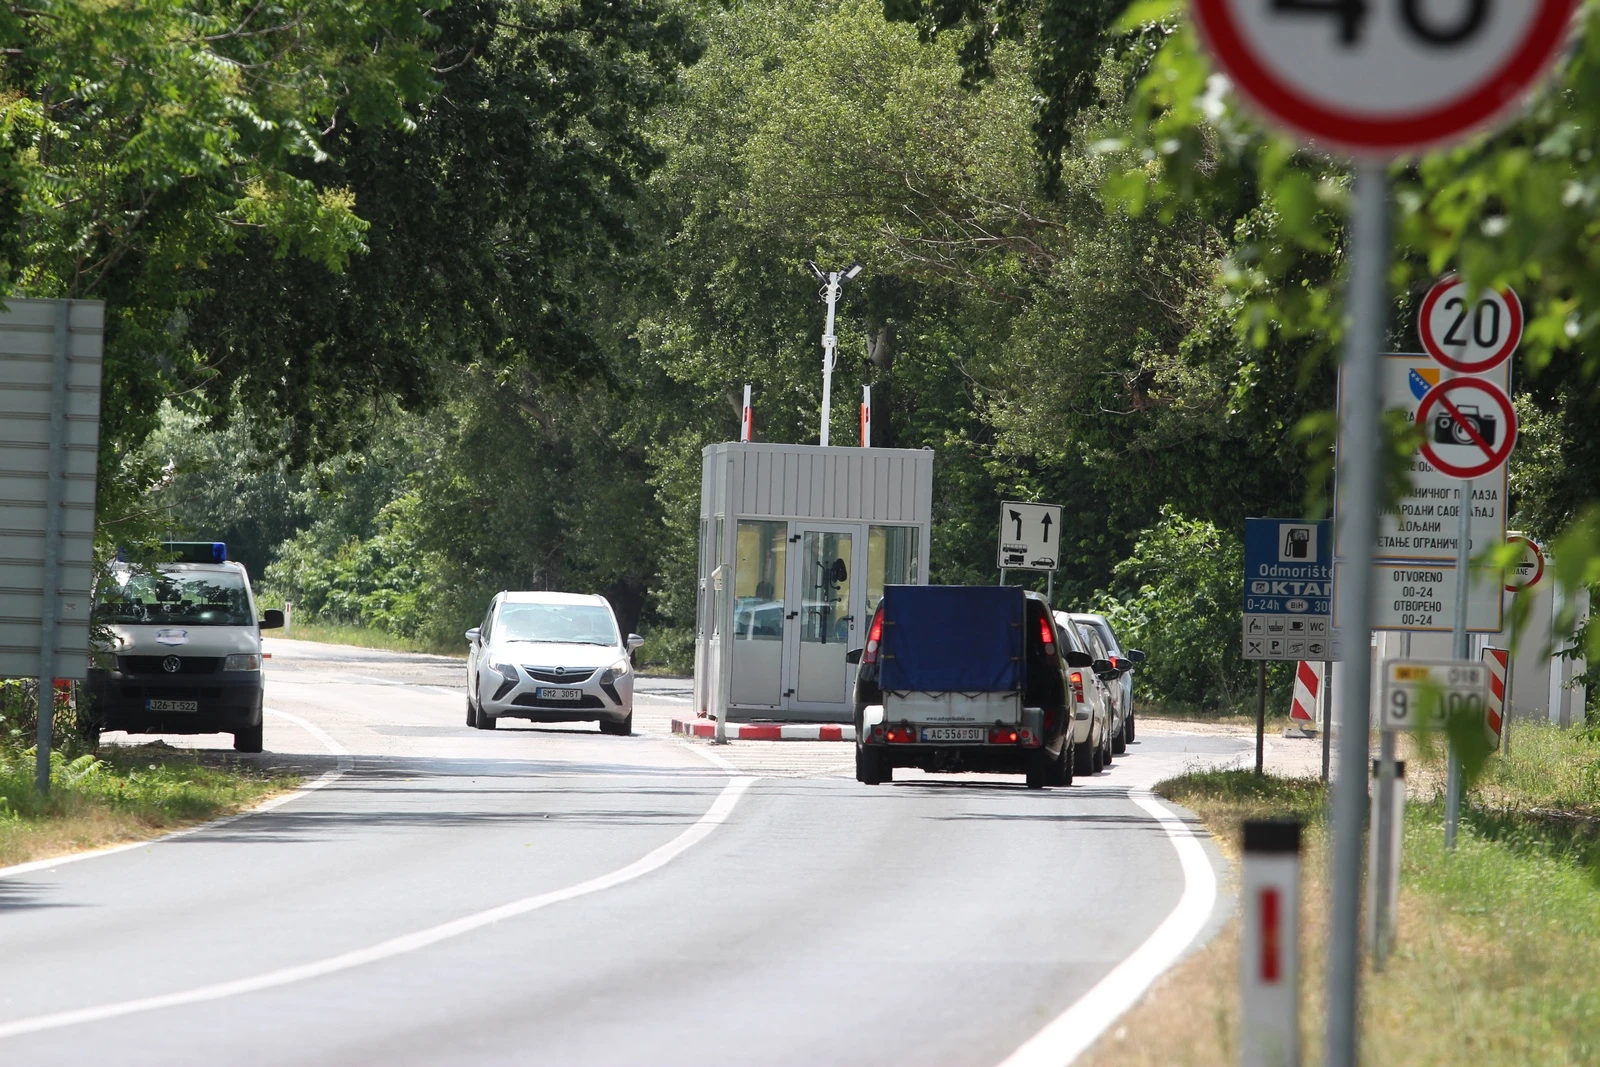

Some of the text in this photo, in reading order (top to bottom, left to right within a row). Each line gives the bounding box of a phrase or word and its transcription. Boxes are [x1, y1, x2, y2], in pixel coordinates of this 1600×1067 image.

[1443, 297, 1500, 348] 20
[1454, 488, 1497, 501] ПЛАЗА
[1398, 520, 1441, 532] ДОЉАНИ
[1377, 536, 1410, 548] ЕТАЊЕ
[1393, 570, 1443, 583] OTVORENO
[1402, 586, 1433, 598] 00-24
[1247, 598, 1280, 611] 0-24h
[1290, 601, 1304, 609] BiH
[1393, 600, 1442, 612] ОТВОРЕНО
[1401, 613, 1433, 625] 00-24
[1309, 622, 1325, 632] WC
[1391, 689, 1408, 719] 9
